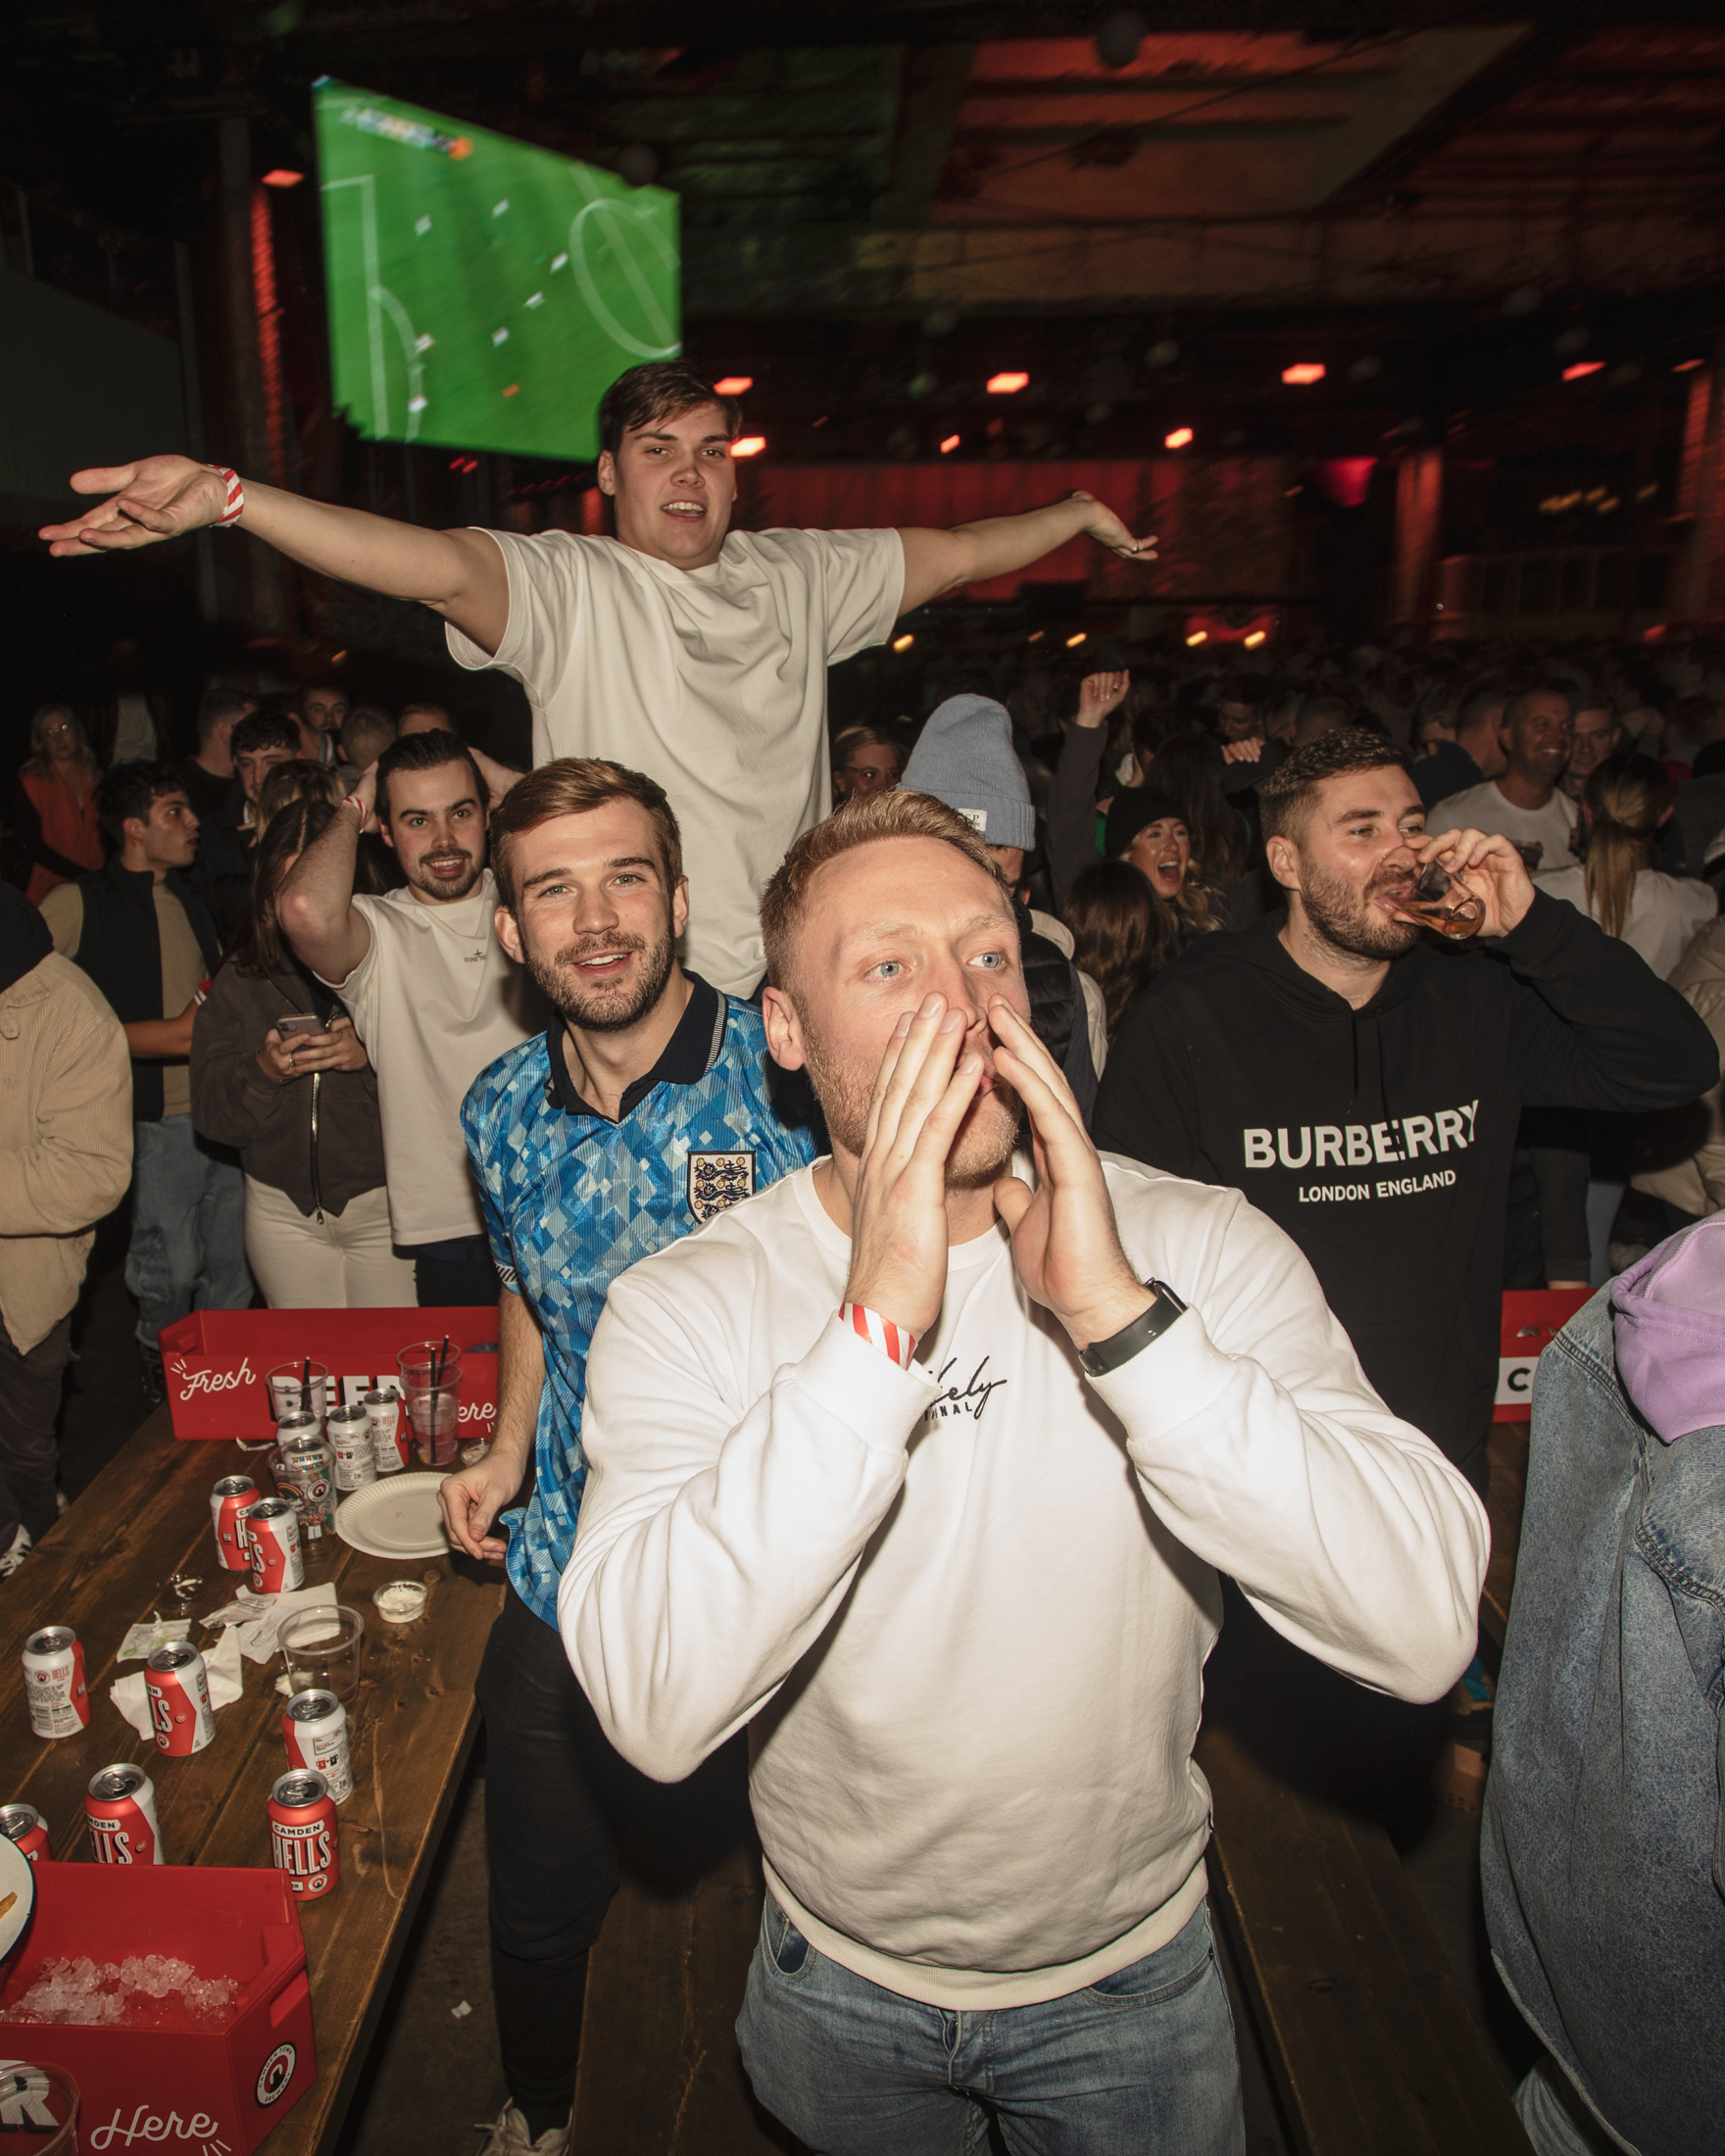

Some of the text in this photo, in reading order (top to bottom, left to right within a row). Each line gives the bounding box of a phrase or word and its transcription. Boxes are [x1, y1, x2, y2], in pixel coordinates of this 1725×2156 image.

[1244, 1099, 1479, 1168] BURBERRY
[1299, 1169, 1456, 1202] LONDON ENGLAND
[179, 1356, 257, 1401] Fresh
[271, 1830, 332, 1876] HELLS
[273, 1824, 321, 1837] CAMDEN
[90, 2104, 220, 2150] Here
